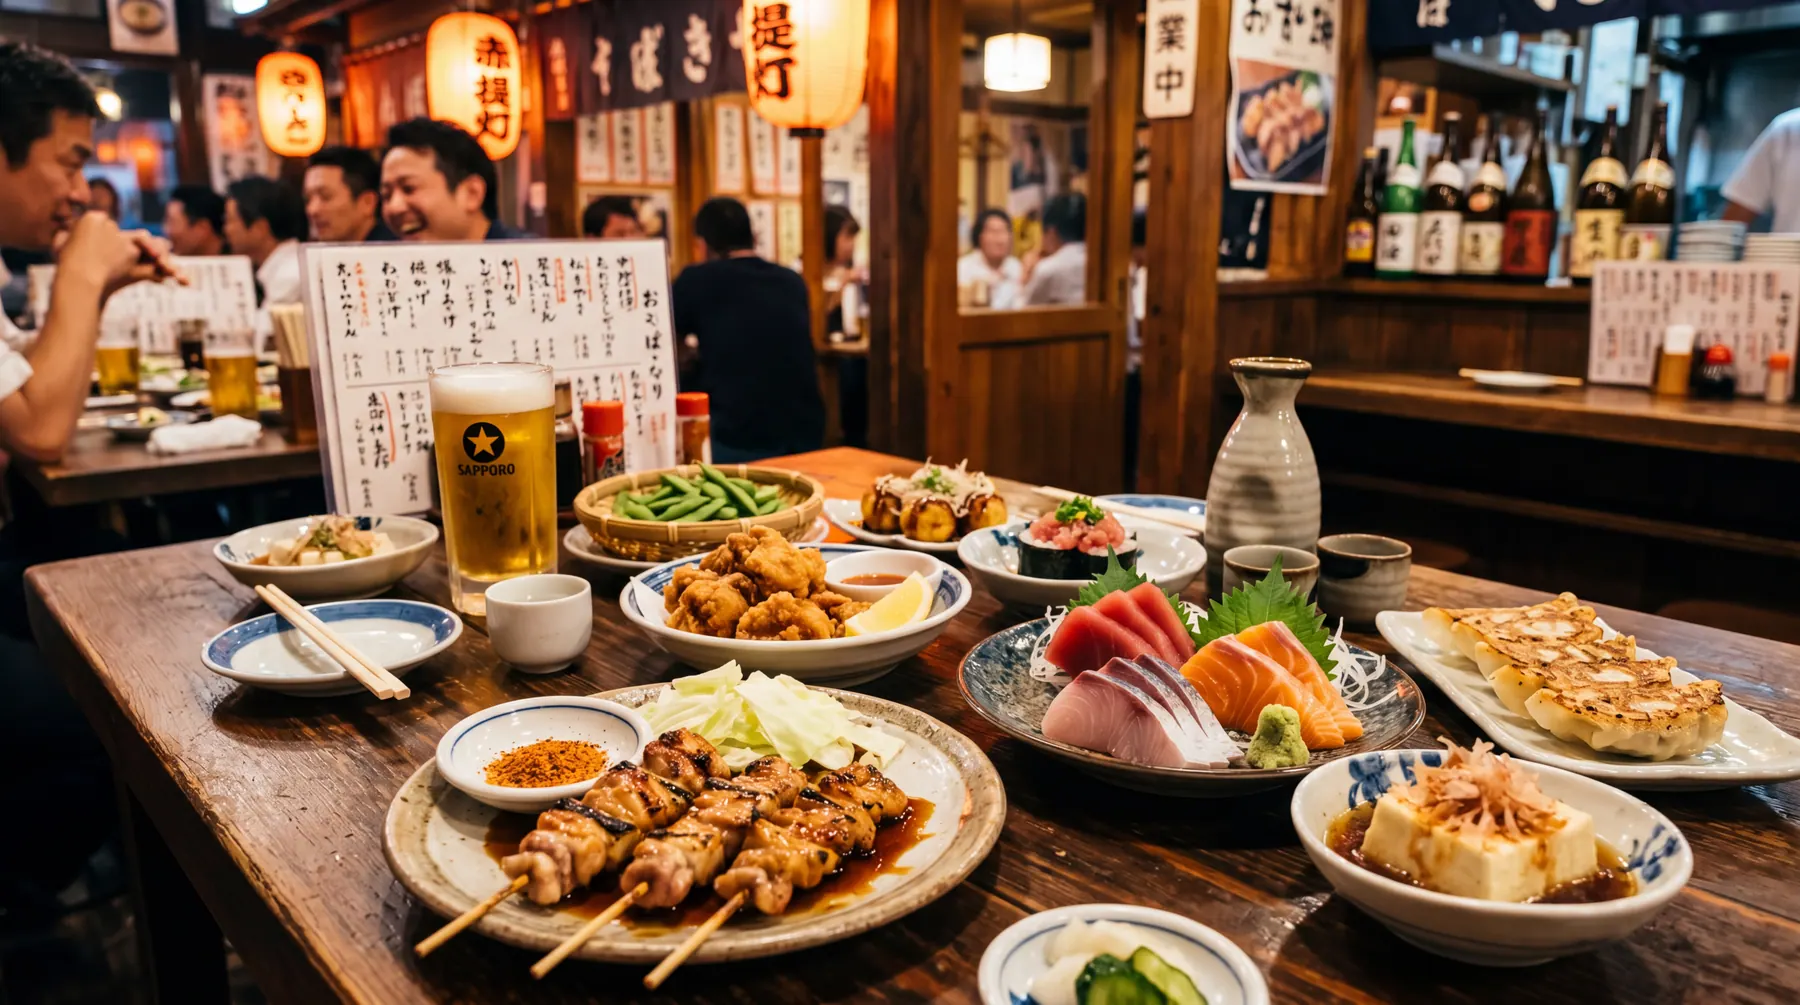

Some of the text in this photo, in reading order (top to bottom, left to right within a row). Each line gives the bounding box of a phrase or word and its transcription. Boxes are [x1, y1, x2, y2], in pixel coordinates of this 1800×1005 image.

[475, 34, 511, 140] 赤提灯
[752, 3, 793, 98] 提灯
[1155, 0, 1185, 101] 業中
[457, 463, 516, 477] SAPPORO
